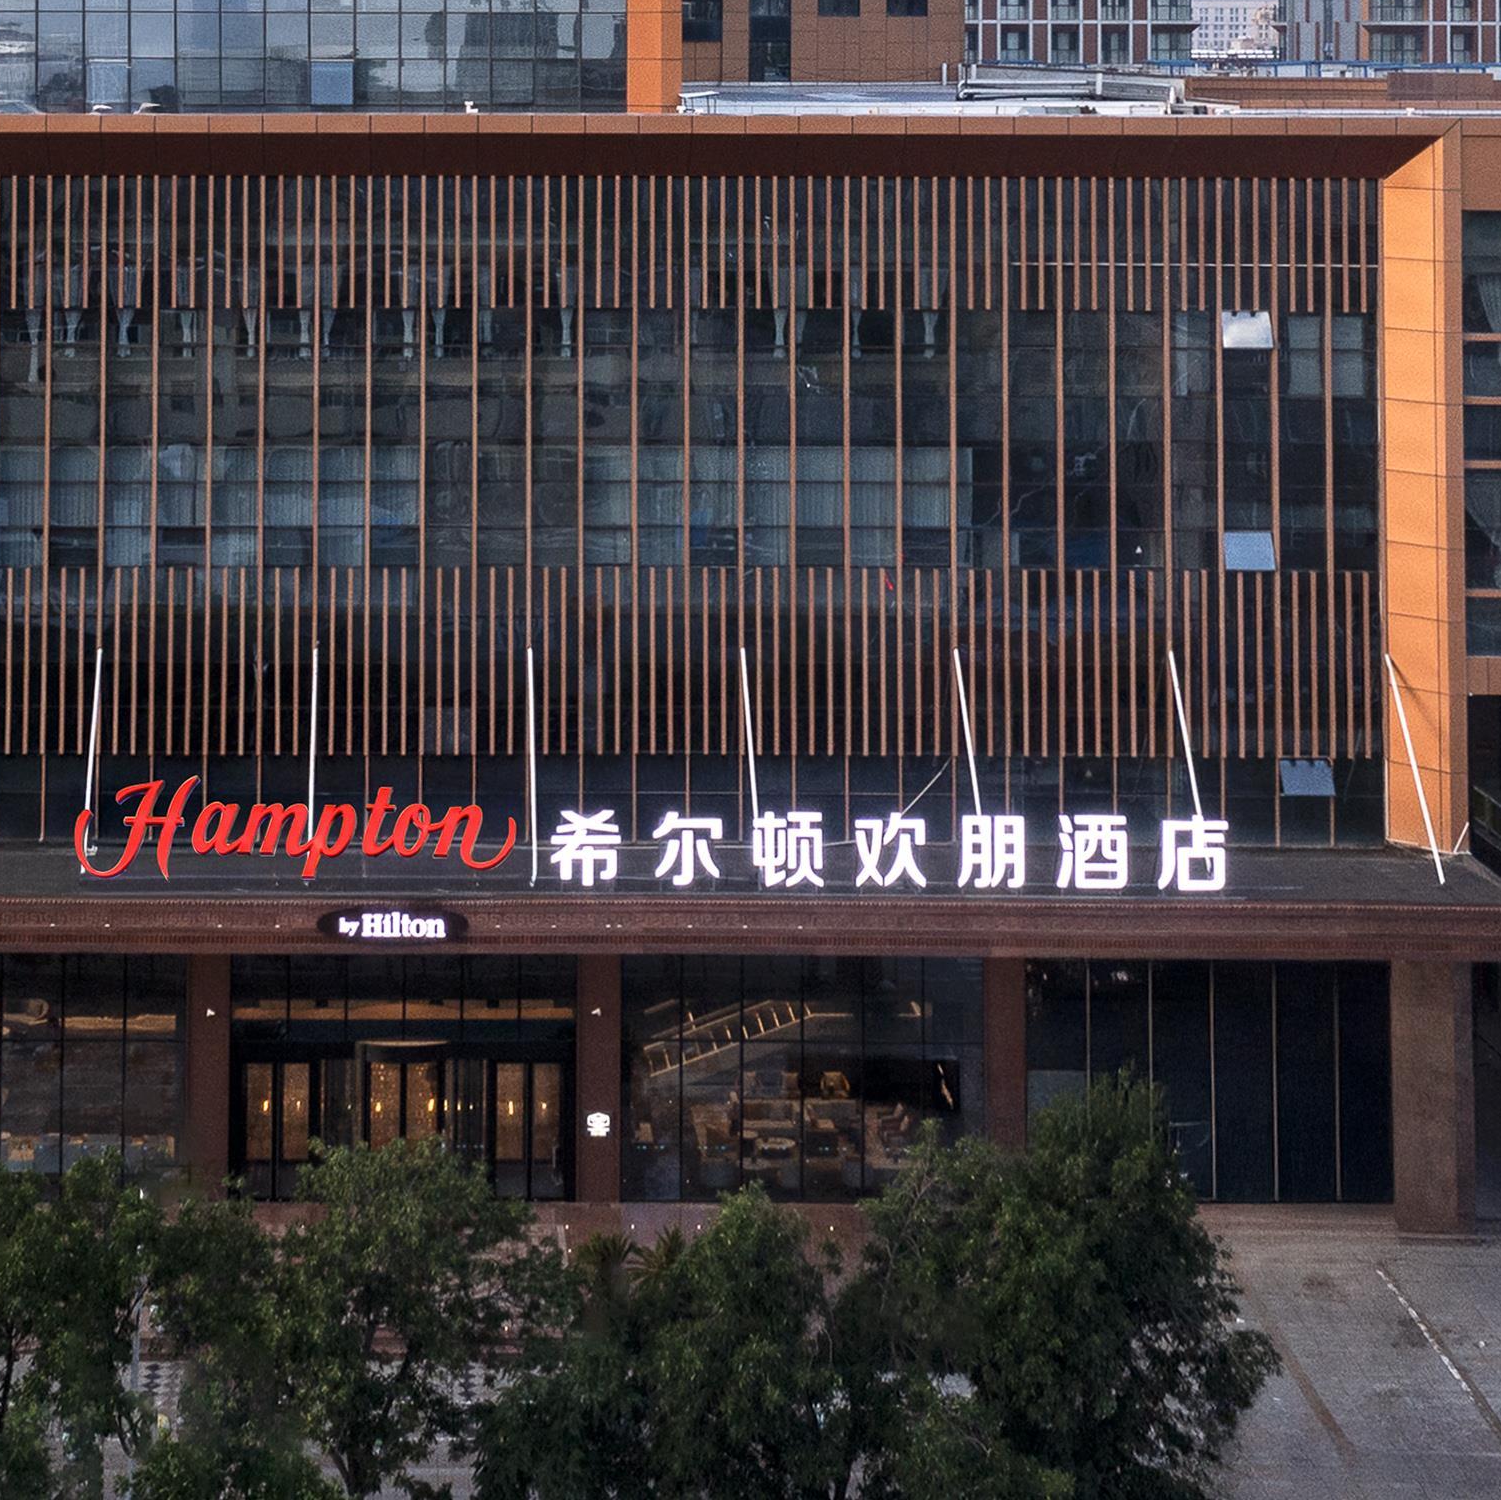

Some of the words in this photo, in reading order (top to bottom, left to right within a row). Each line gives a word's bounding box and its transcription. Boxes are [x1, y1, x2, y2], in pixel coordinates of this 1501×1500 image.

[74, 774, 517, 881] Hampton
[550, 809, 1230, 892] 希尔顿欢朋酒店
[338, 916, 360, 937] by
[361, 912, 447, 939] Hilton
